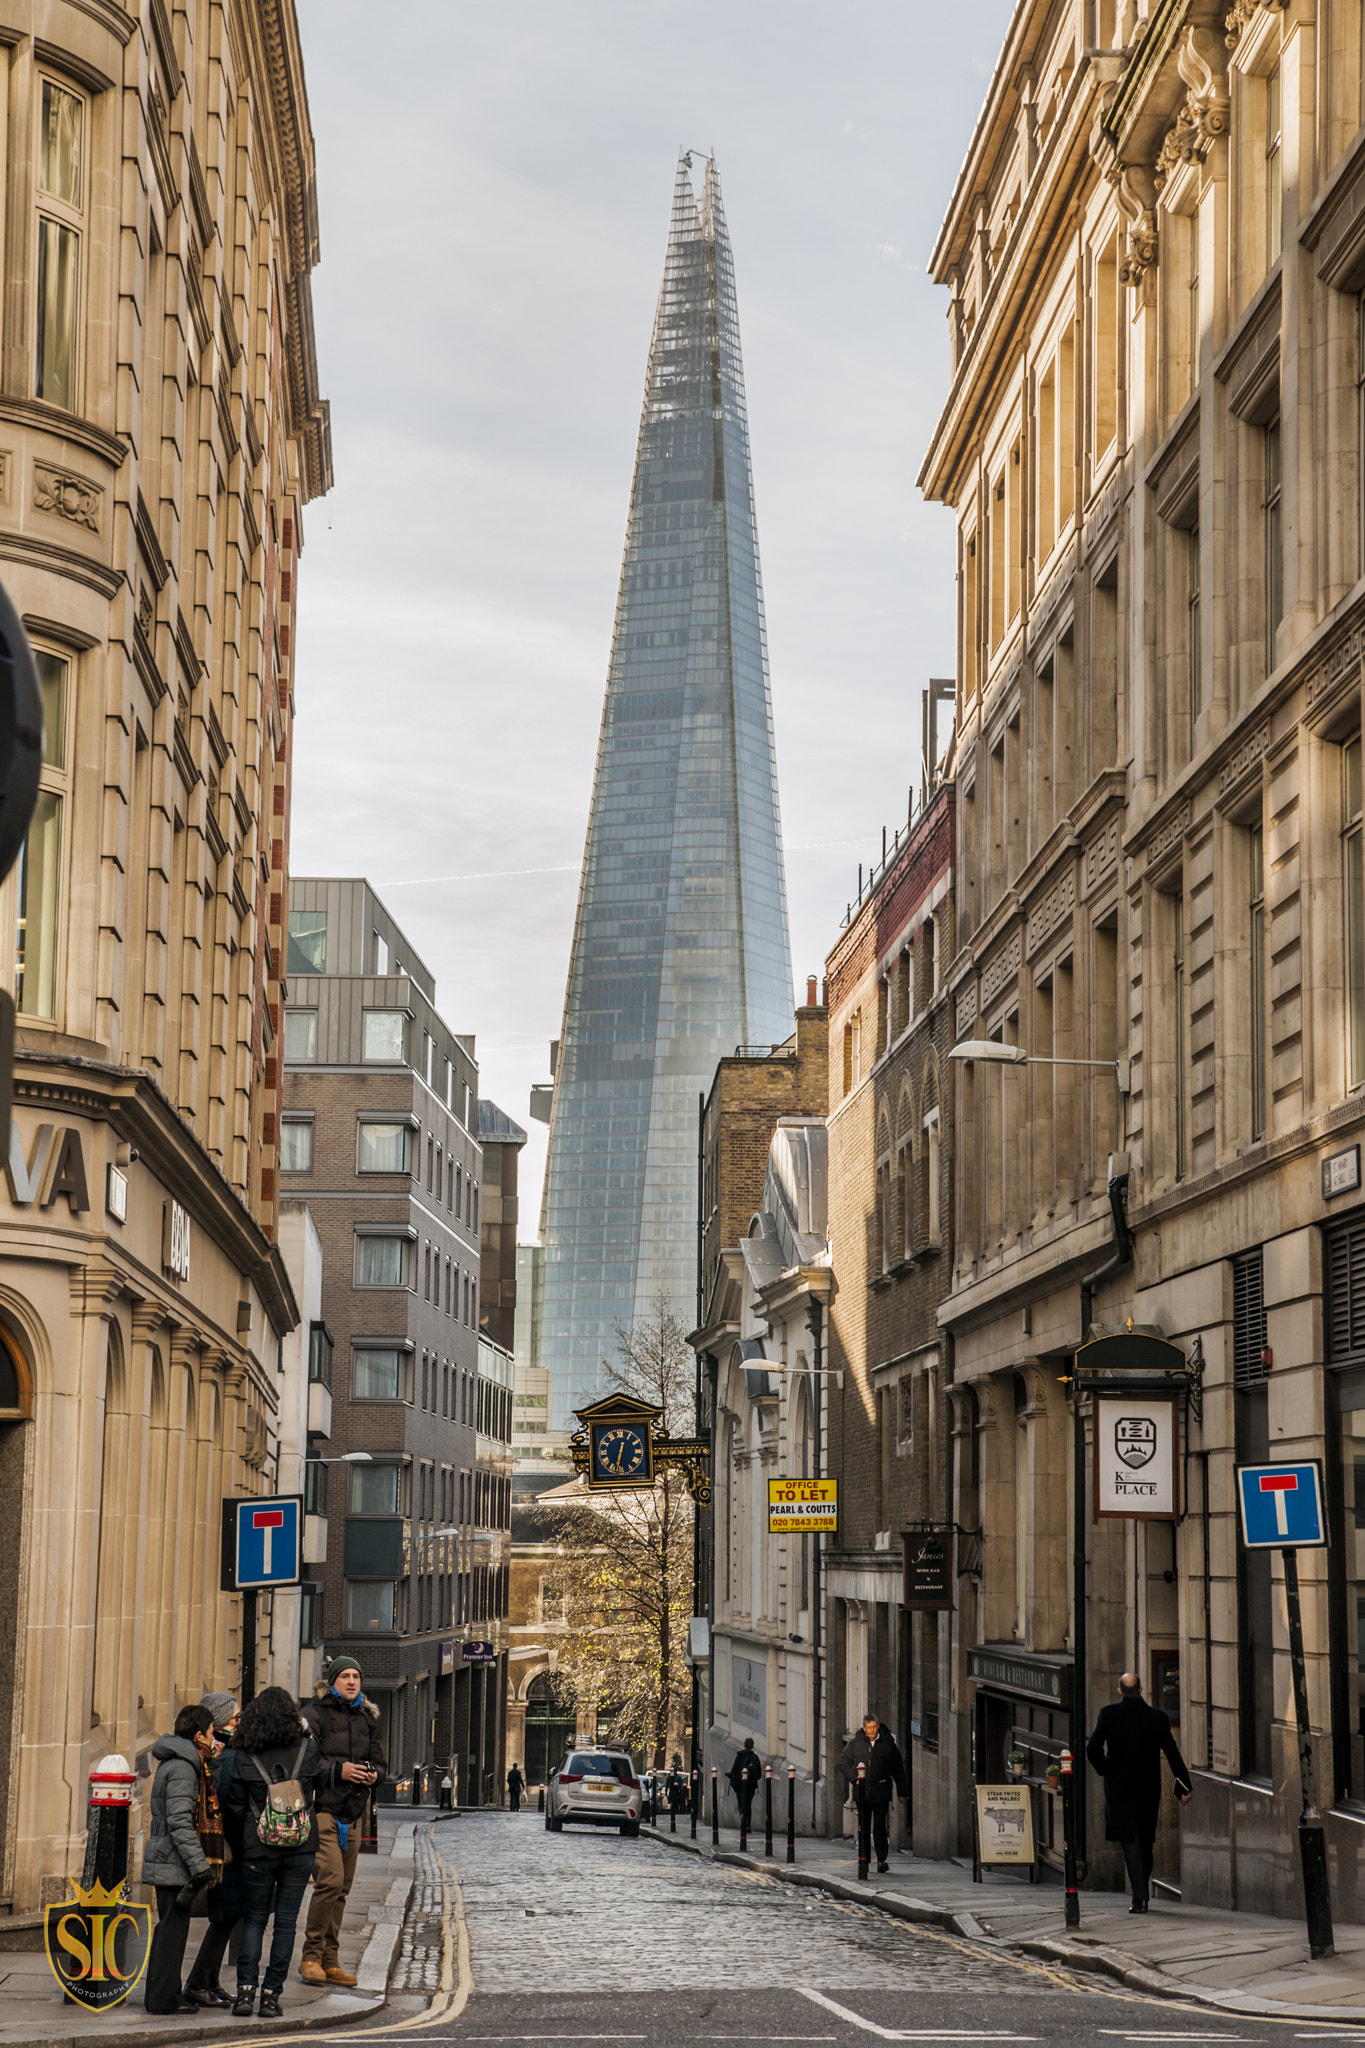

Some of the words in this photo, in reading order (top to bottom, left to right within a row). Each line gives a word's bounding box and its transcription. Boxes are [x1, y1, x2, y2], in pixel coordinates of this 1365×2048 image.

[168, 1199, 190, 1282] BBVA
[1115, 1471, 1124, 1481] K
[785, 1481, 819, 1489] OFFICE
[1115, 1485, 1157, 1495] PLACE
[776, 1490, 796, 1501] TO
[801, 1489, 829, 1501] LET
[770, 1505, 795, 1514] PEARL
[797, 1505, 804, 1514] &
[806, 1504, 836, 1514] COUTTS
[772, 1518, 788, 1526] 020
[790, 1518, 811, 1526] 7843
[813, 1517, 834, 1526] 3788
[1012, 1666, 1045, 1690] RESTAURANT
